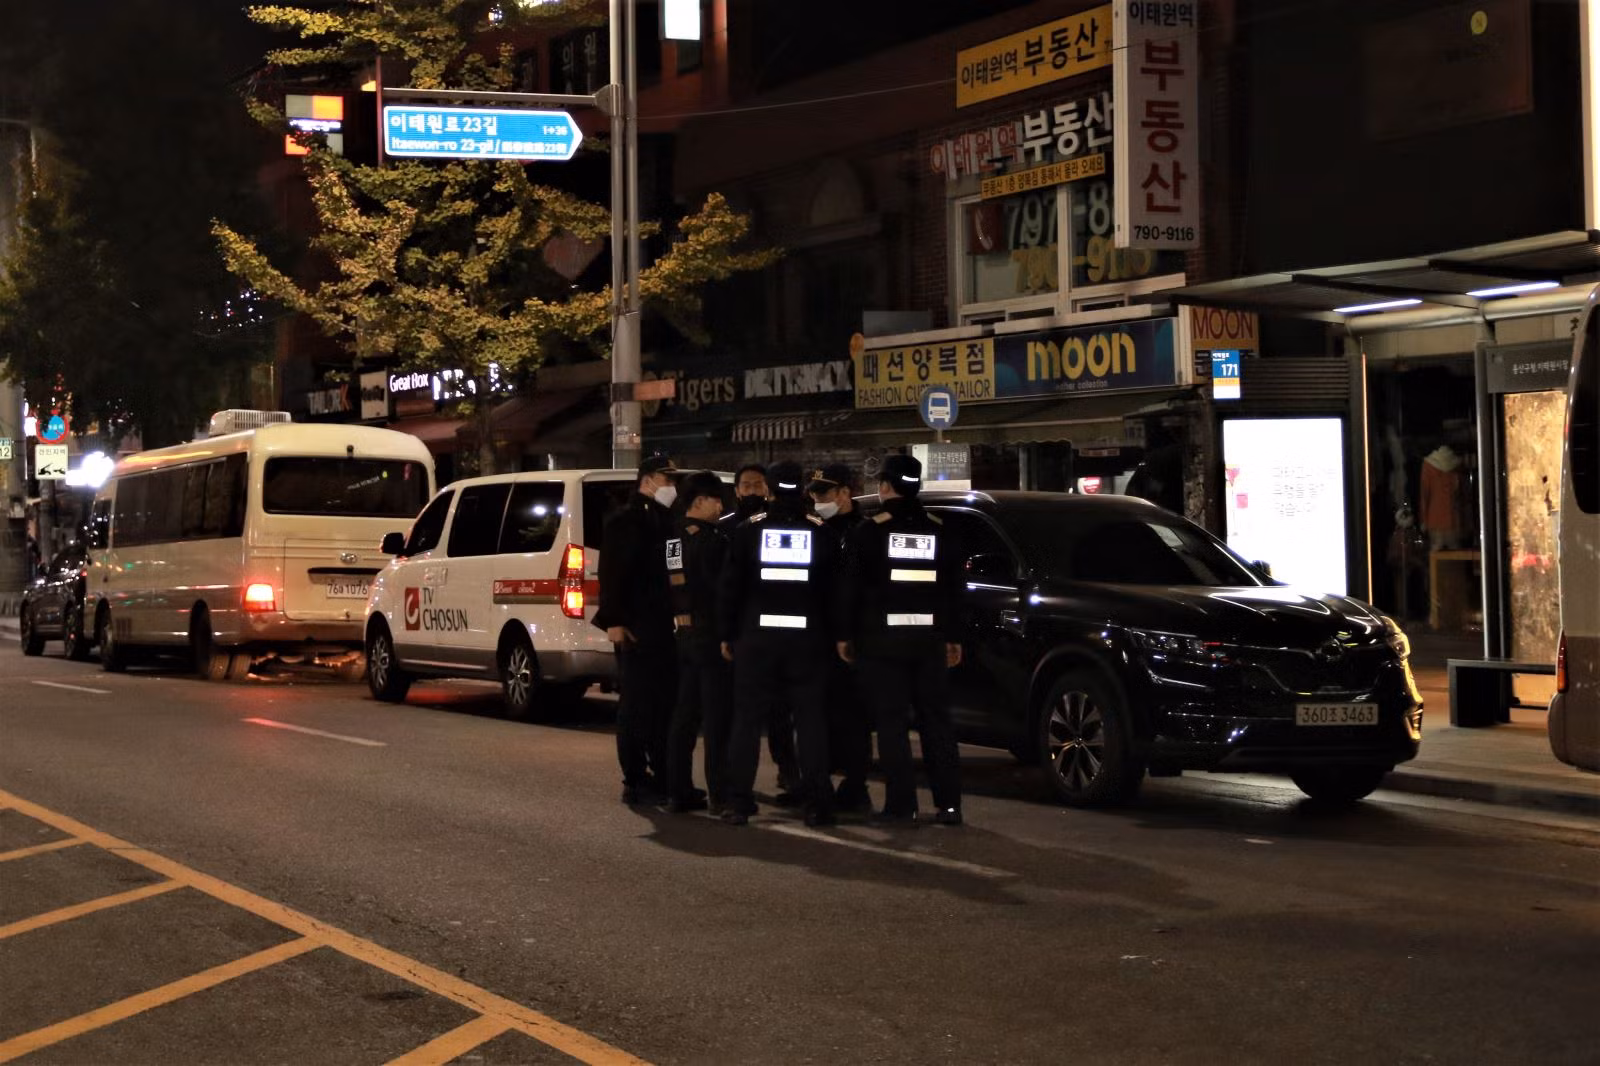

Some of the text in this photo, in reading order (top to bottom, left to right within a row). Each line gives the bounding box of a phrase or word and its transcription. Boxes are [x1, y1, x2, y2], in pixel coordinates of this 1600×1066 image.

[1129, 2, 1193, 27] 이태원역
[961, 49, 1018, 89] 이태원역
[1024, 17, 1099, 77] 부동산
[930, 91, 1113, 182] 이태원역 부동산
[1140, 38, 1187, 213] 부동산
[1079, 154, 1103, 174] 오세요
[1004, 179, 1114, 253] 797-8
[1134, 225, 1195, 241] 790-9116
[1192, 307, 1254, 340] MOON
[1026, 332, 1137, 382] moon
[389, 374, 412, 393] Great
[411, 372, 430, 389] Box
[1221, 363, 1238, 377] 171
[858, 387, 902, 406] FASHION
[953, 379, 991, 401] TAILOR
[345, 583, 368, 595] 1076
[422, 586, 435, 604] TV
[422, 607, 469, 632] CHOSUN
[1301, 706, 1374, 723] 360조 3463
